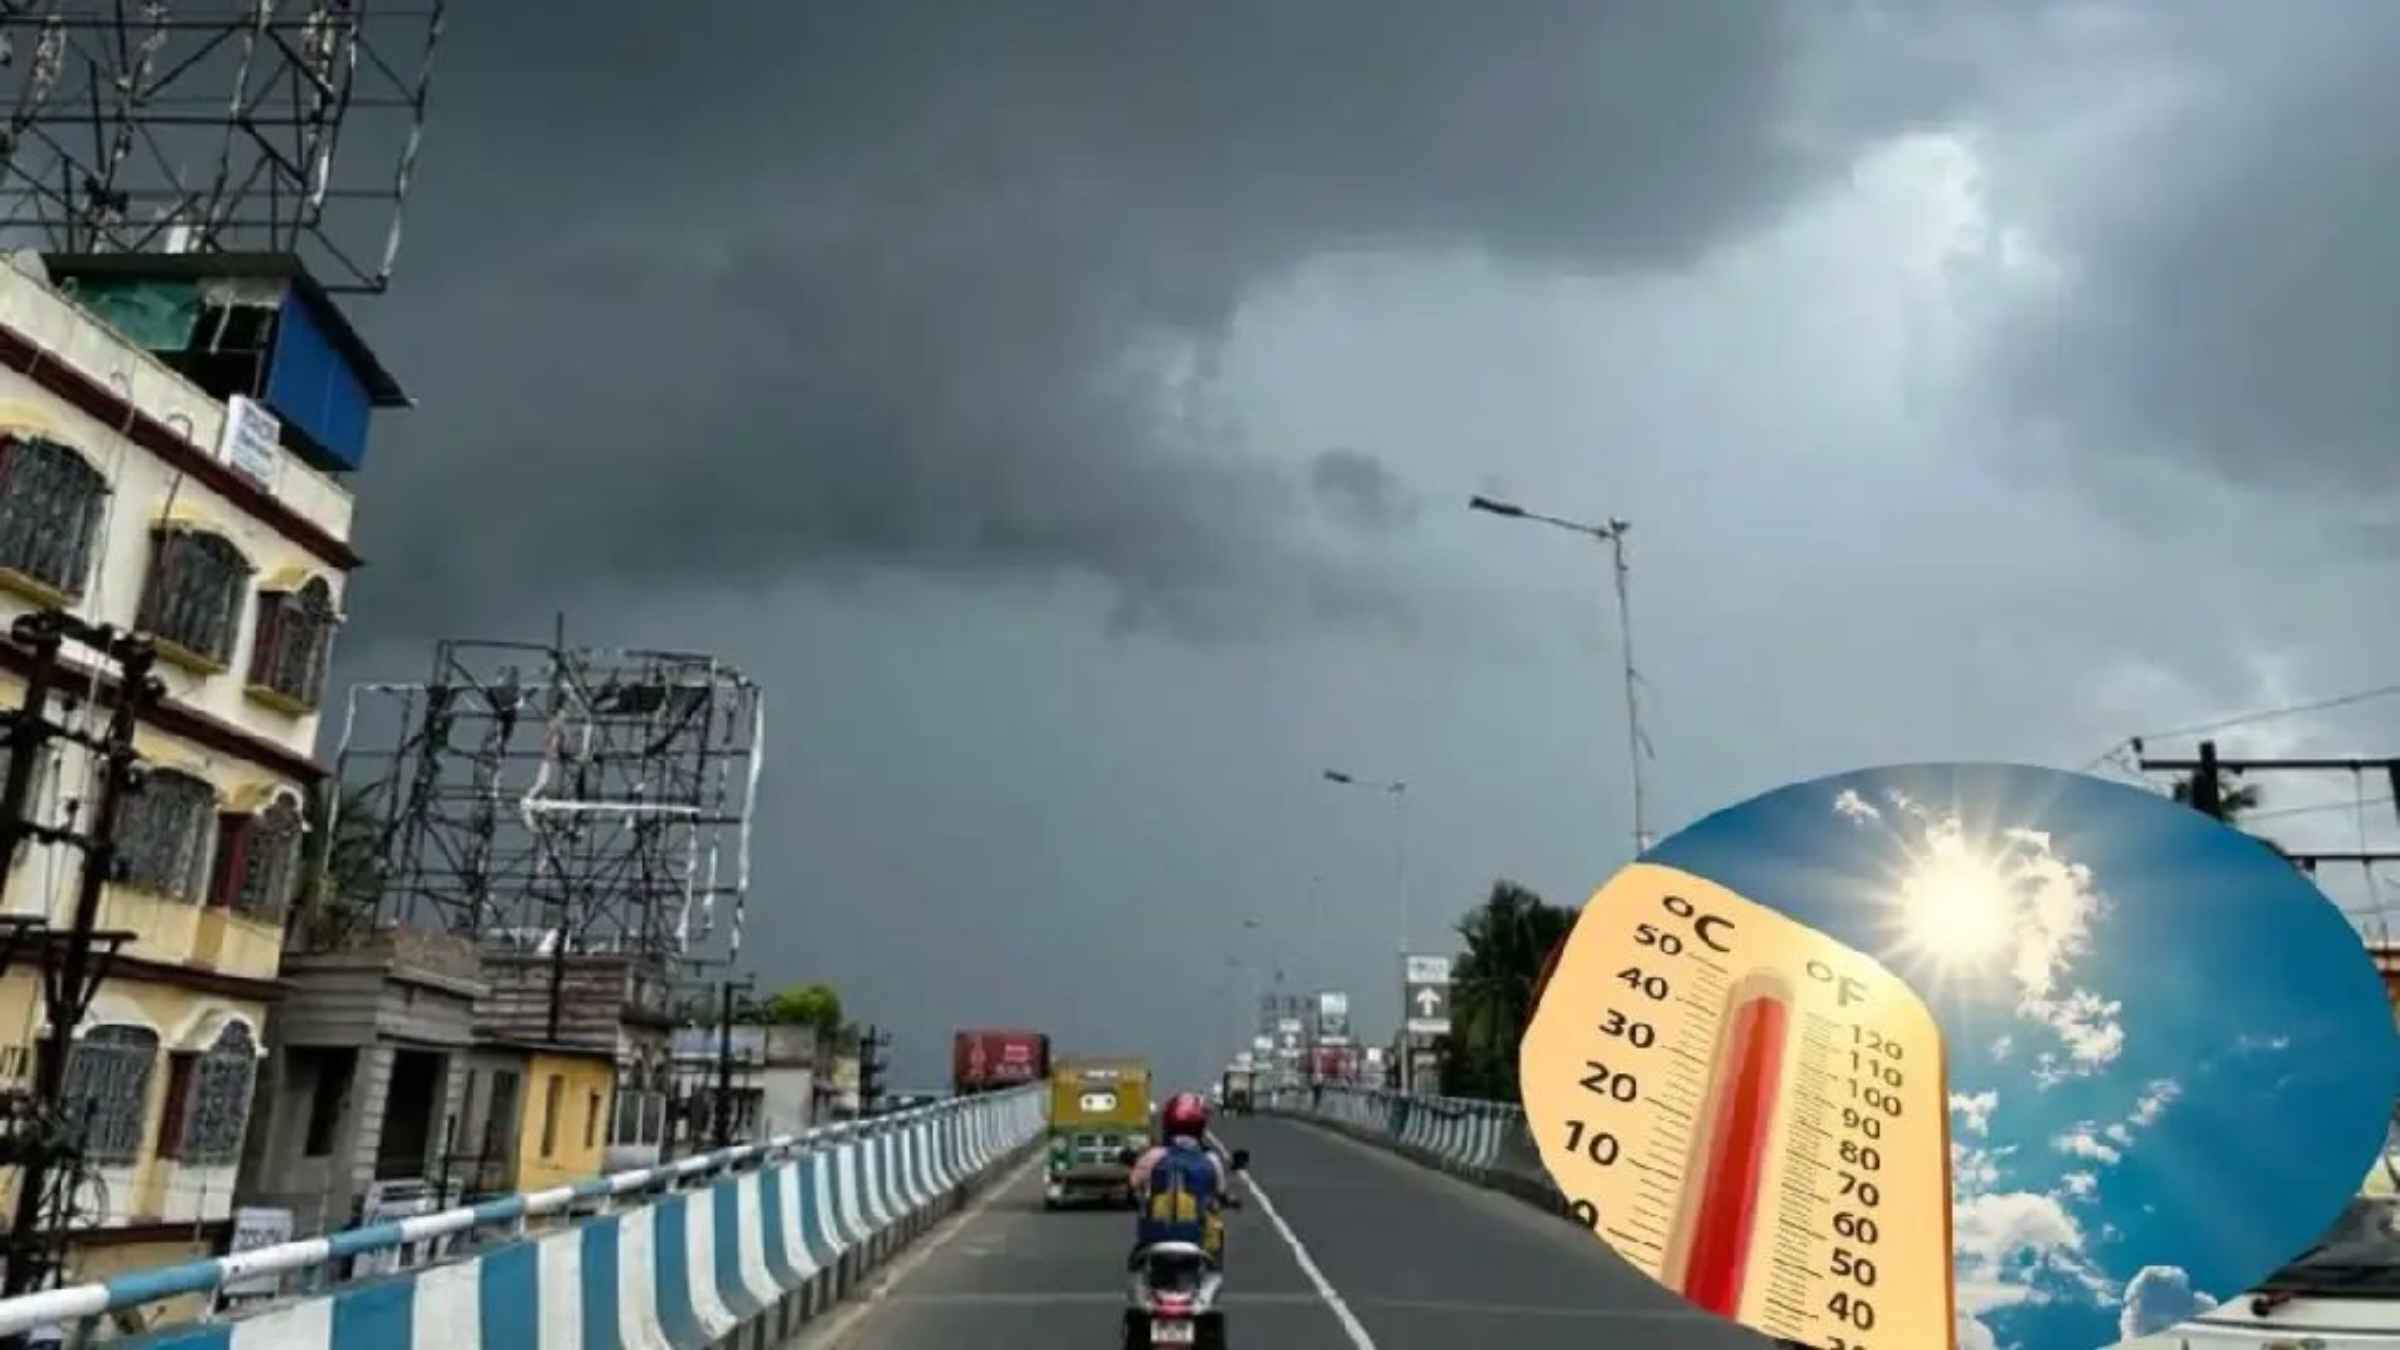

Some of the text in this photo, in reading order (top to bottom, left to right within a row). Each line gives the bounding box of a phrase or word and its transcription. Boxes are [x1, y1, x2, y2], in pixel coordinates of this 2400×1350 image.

[1633, 922, 1683, 956] 50
[1616, 967, 1669, 1002] 40
[1598, 1008, 1655, 1050] 30
[1851, 1024, 1904, 1061] 120
[1578, 1060, 1638, 1103] 20
[1849, 1052, 1904, 1088] 110
[1847, 1077, 1902, 1118] 100
[1843, 1108, 1882, 1140] 90
[1564, 1120, 1620, 1167] 10
[1839, 1141, 1882, 1171] 80
[1837, 1172, 1880, 1207] 70
[1832, 1211, 1879, 1245] 60
[1829, 1248, 1877, 1288] 50
[1827, 1292, 1876, 1331] 40
